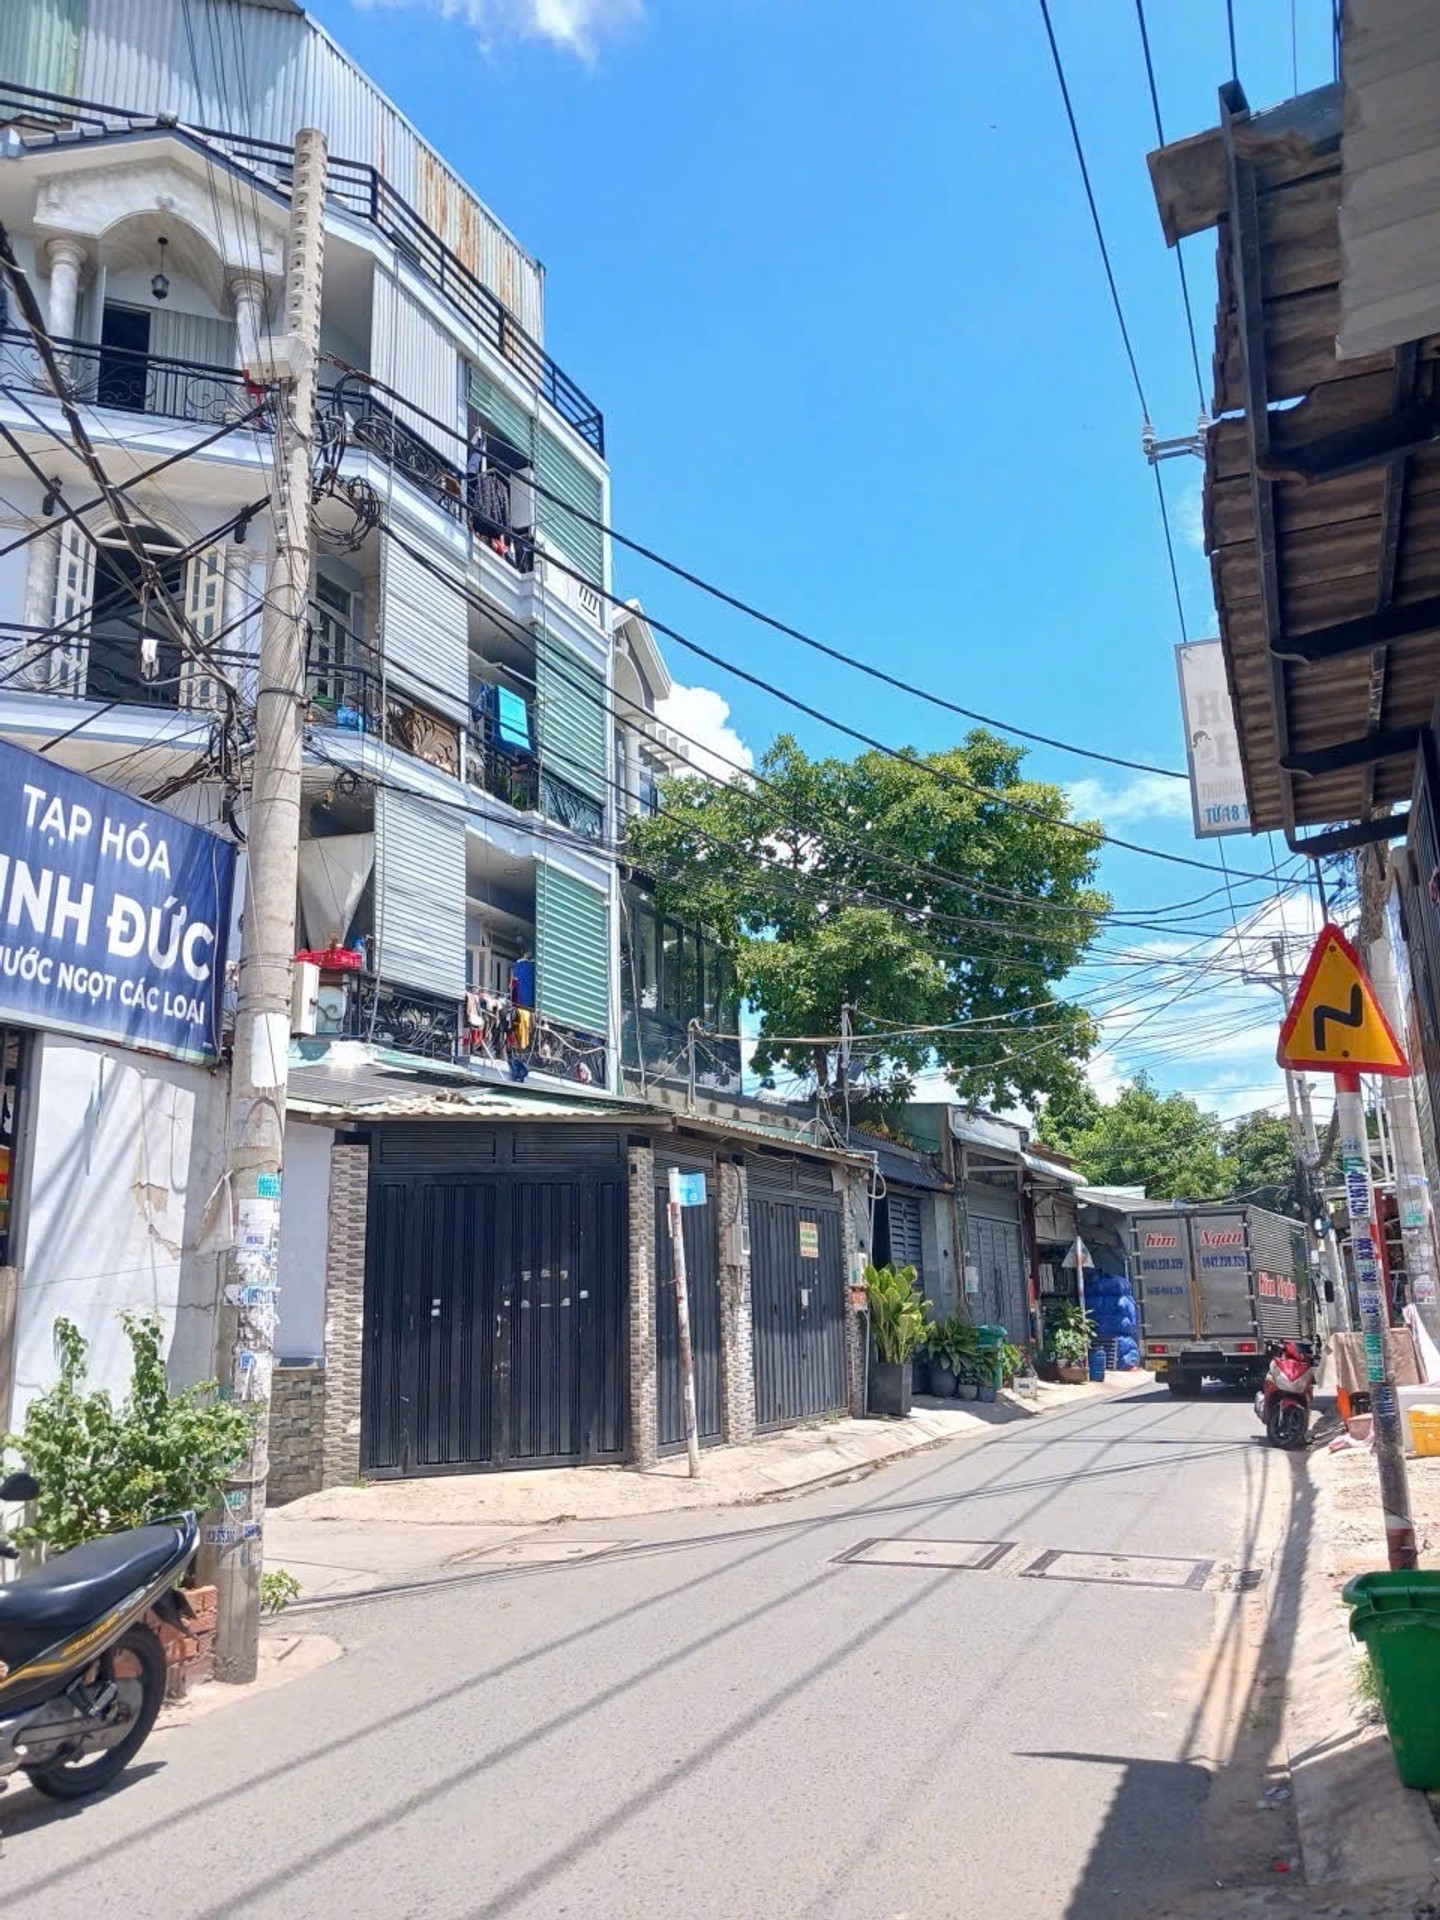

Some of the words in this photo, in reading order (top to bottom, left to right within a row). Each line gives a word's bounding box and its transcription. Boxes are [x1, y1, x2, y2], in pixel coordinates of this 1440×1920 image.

[23, 783, 93, 847] TẠP
[100, 815, 171, 880] HÓA
[1225, 804, 1240, 823] 18
[106, 893, 214, 981] ĐỨC
[57, 962, 117, 1004] NGỌT
[119, 977, 160, 1013] CÁC
[163, 991, 206, 1026] LOẠI
